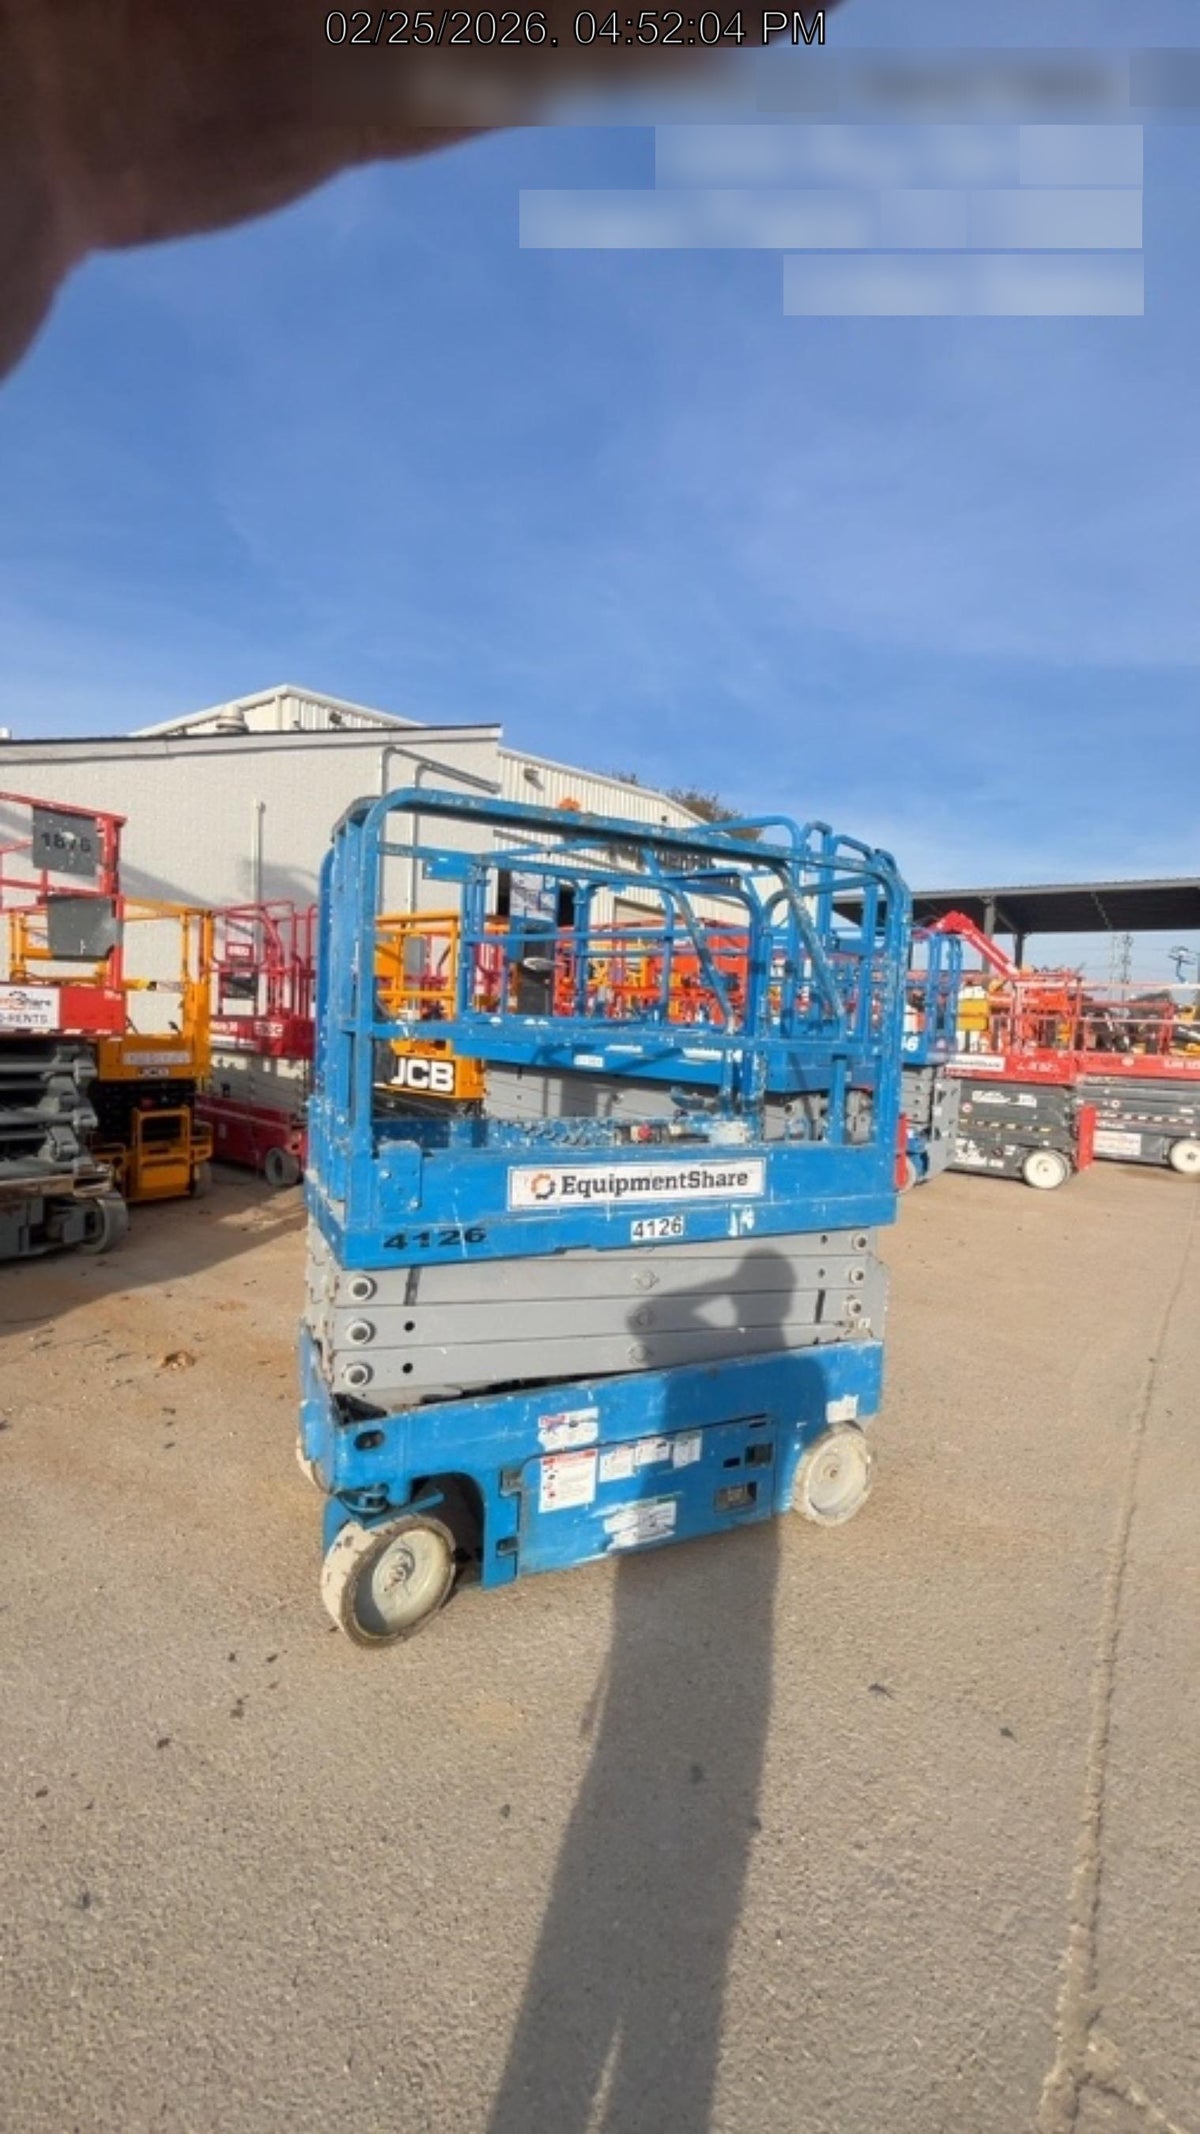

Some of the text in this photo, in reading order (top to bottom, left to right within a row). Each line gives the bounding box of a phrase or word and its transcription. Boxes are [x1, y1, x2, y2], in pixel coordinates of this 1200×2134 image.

[390, 1057, 455, 1092] JCB
[561, 1170, 749, 1198] EquipmentShare
[382, 1227, 487, 1250] 4126
[632, 1216, 683, 1239] 4126
